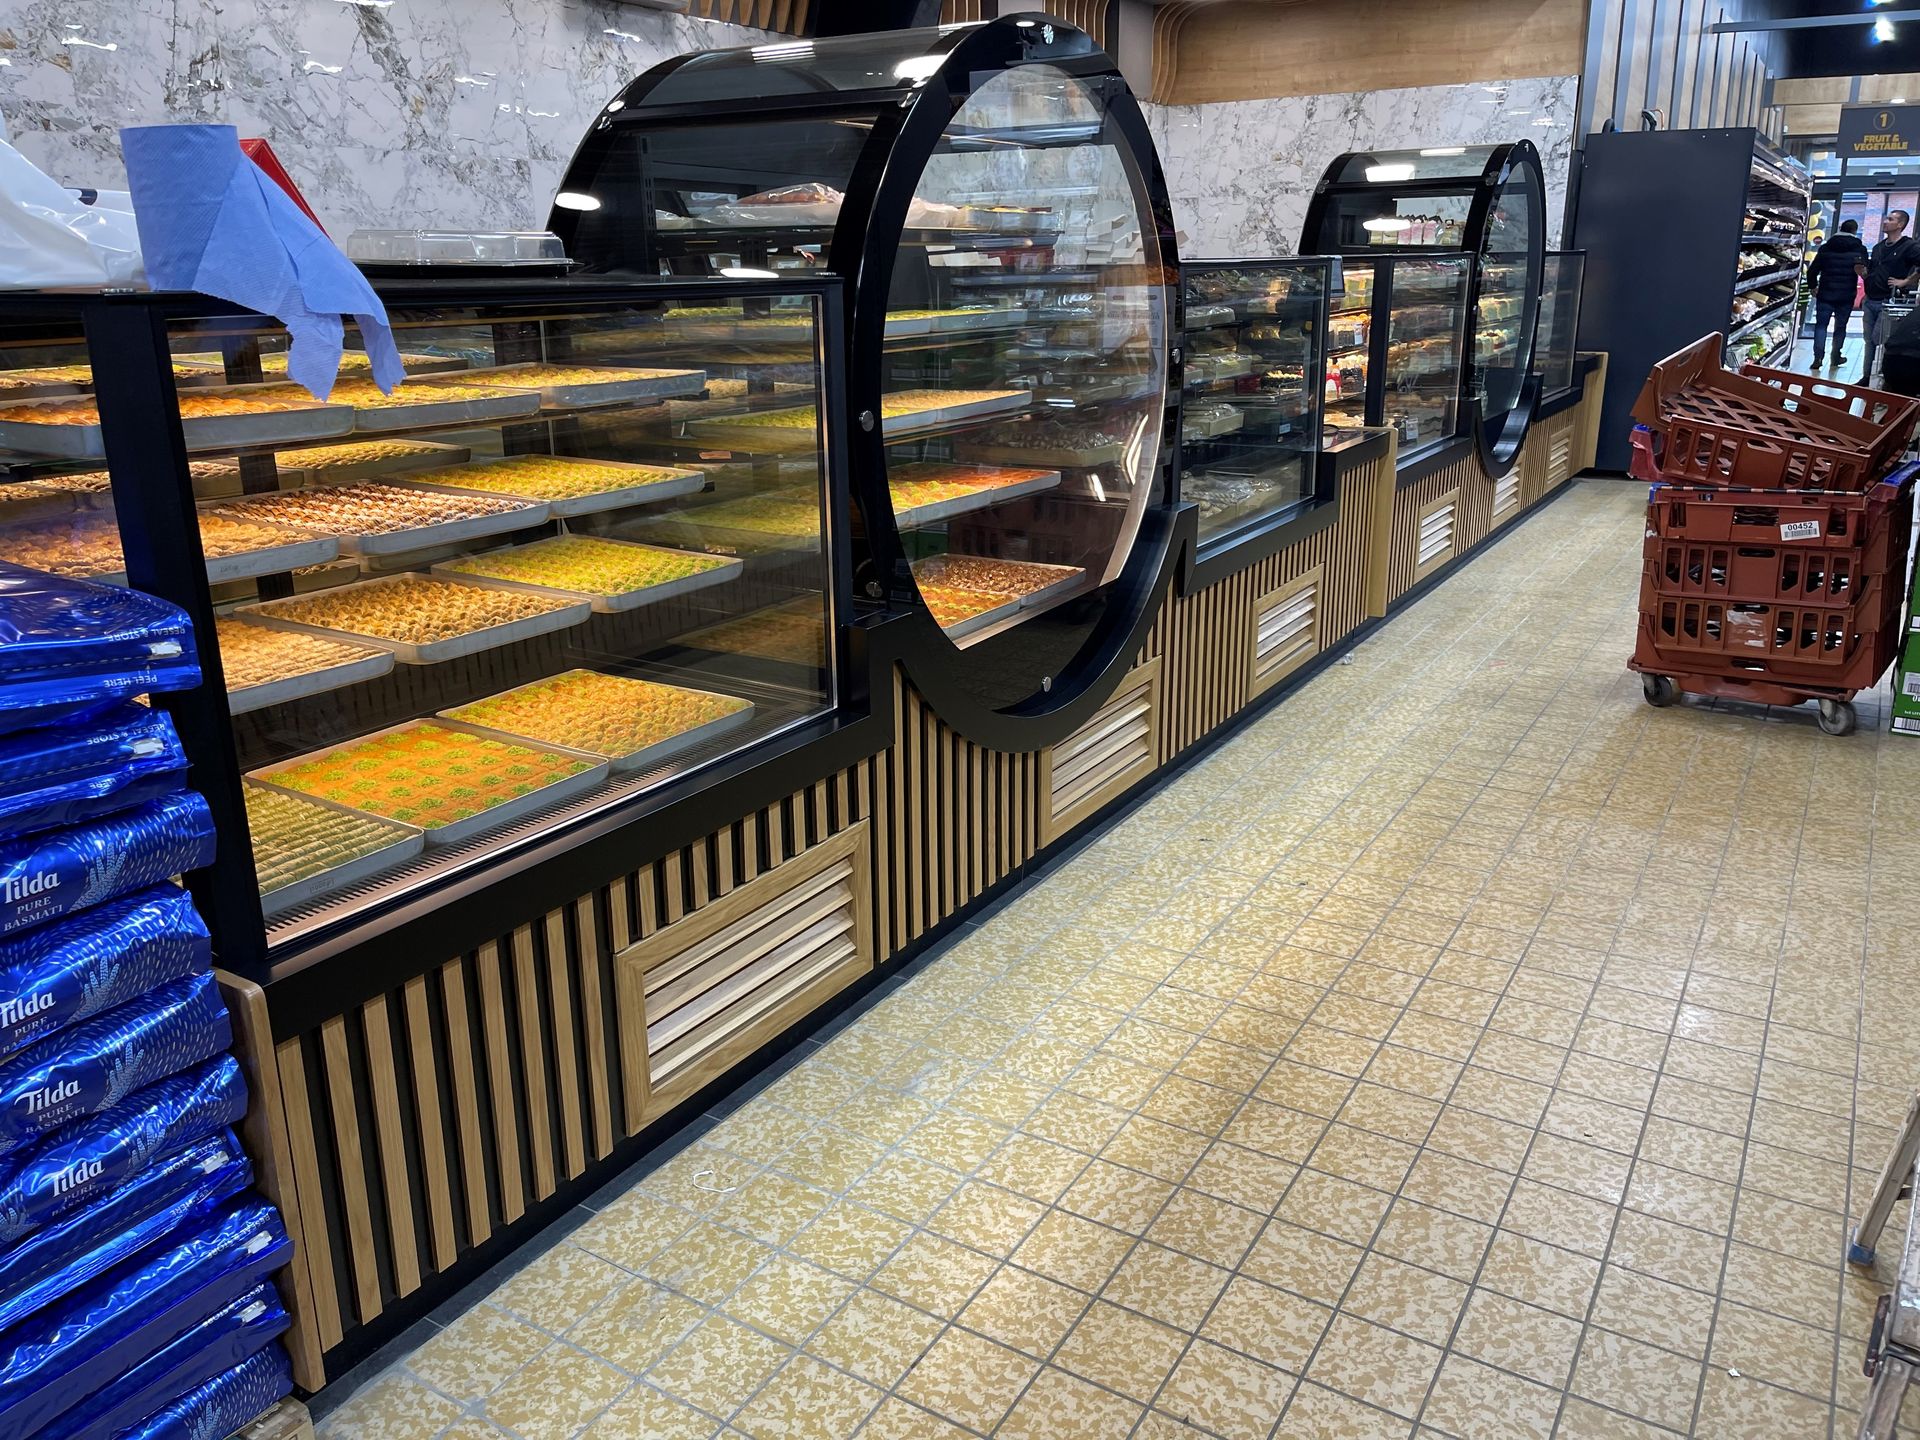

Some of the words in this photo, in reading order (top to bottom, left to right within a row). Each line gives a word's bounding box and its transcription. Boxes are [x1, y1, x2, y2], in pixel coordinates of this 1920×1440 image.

[1880, 113, 1888, 128] 1
[1863, 135, 1892, 143] FRUIT
[1892, 134, 1900, 142] &
[1853, 142, 1909, 151] VEGETABLE
[1787, 522, 1813, 531] 00452
[108, 631, 141, 642] STORE
[151, 626, 186, 635] RESEAL
[103, 678, 132, 688] HERE
[133, 674, 158, 684] PEEL
[132, 723, 166, 736] RESEAL
[86, 732, 120, 745] STORE
[89, 778, 117, 790] HERE
[0, 871, 61, 904] Tilda
[17, 896, 52, 914] PURE
[4, 904, 63, 931] BASMATI
[0, 992, 56, 1029] Tilda
[14, 1016, 48, 1038] PURE
[14, 1080, 82, 1115] Tilda
[25, 1106, 86, 1133] BASMATI
[38, 1103, 73, 1121] PURE
[39, 1160, 105, 1197] Tilda
[170, 1199, 192, 1216] HERE
